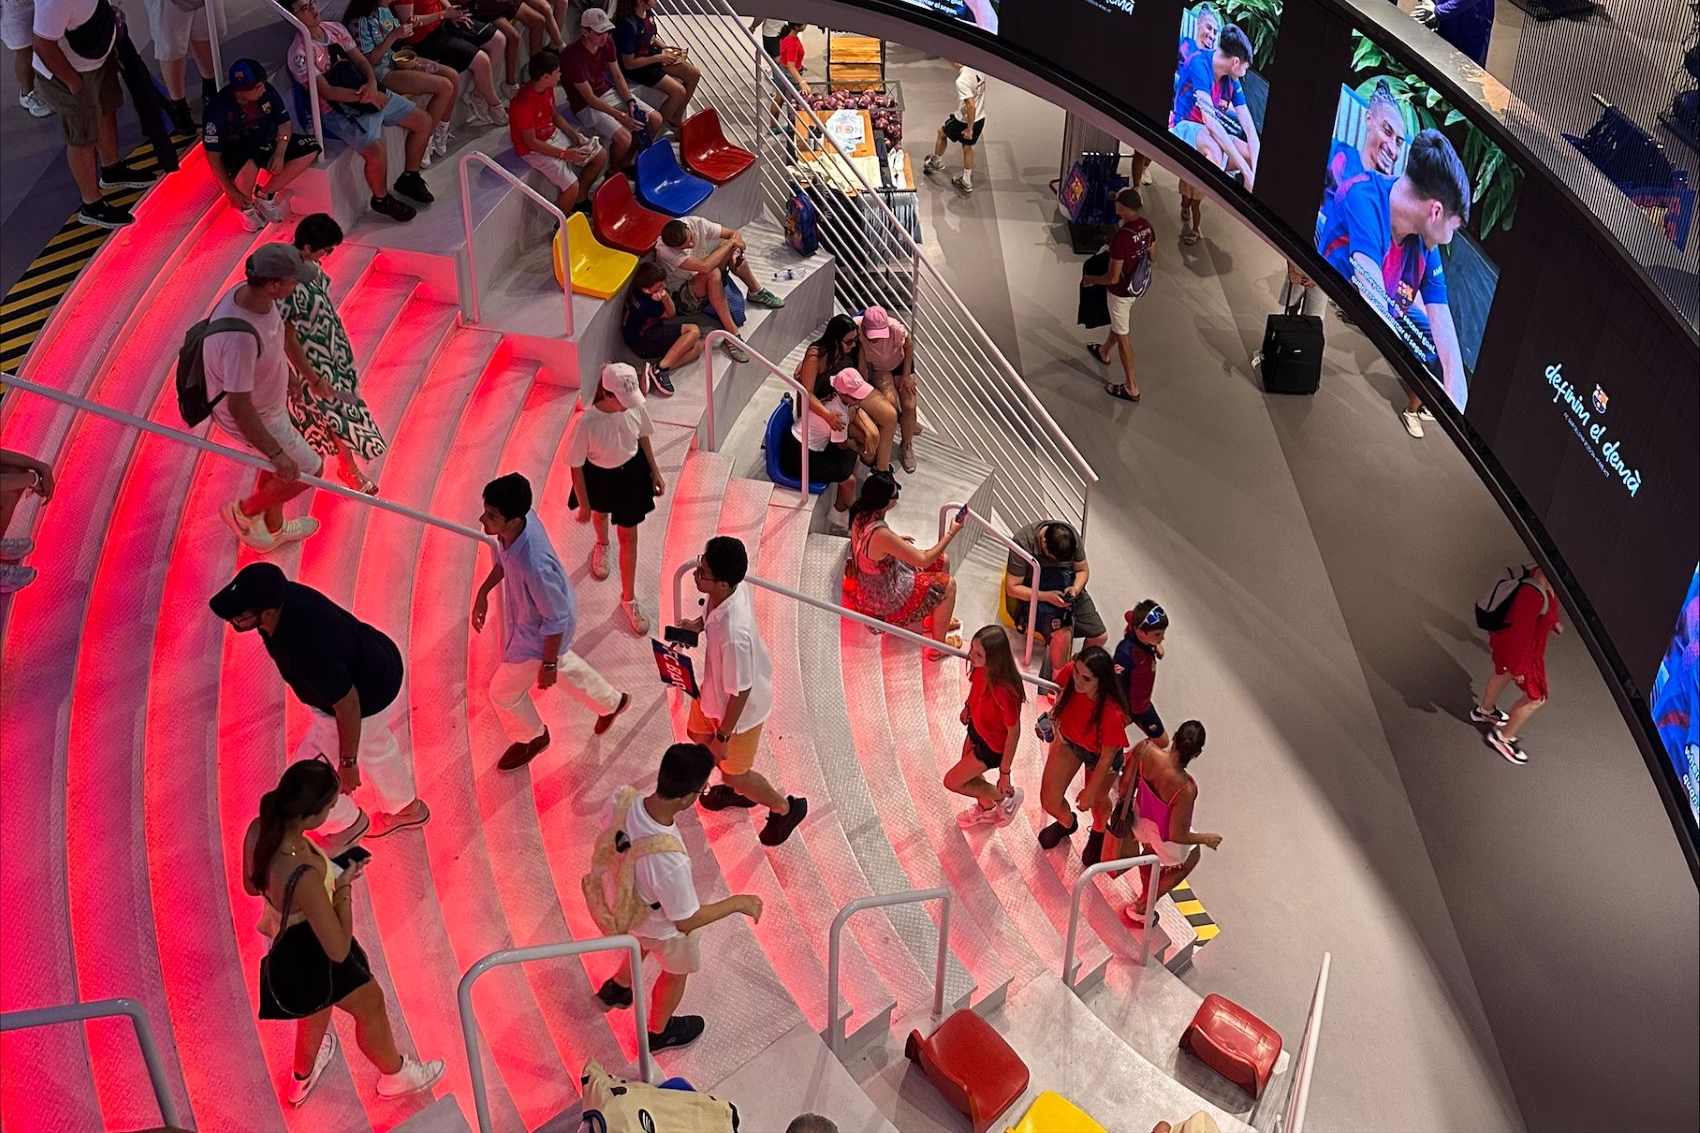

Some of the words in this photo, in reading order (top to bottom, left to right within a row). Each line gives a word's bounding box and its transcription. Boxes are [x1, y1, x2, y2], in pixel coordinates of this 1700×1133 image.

[1385, 313, 1404, 334] marcar
[1403, 332, 1412, 342] el
[1403, 315, 1423, 339] second
[1545, 363, 1591, 426] definim
[1590, 423, 1606, 444] el
[1602, 441, 1641, 498] demà
